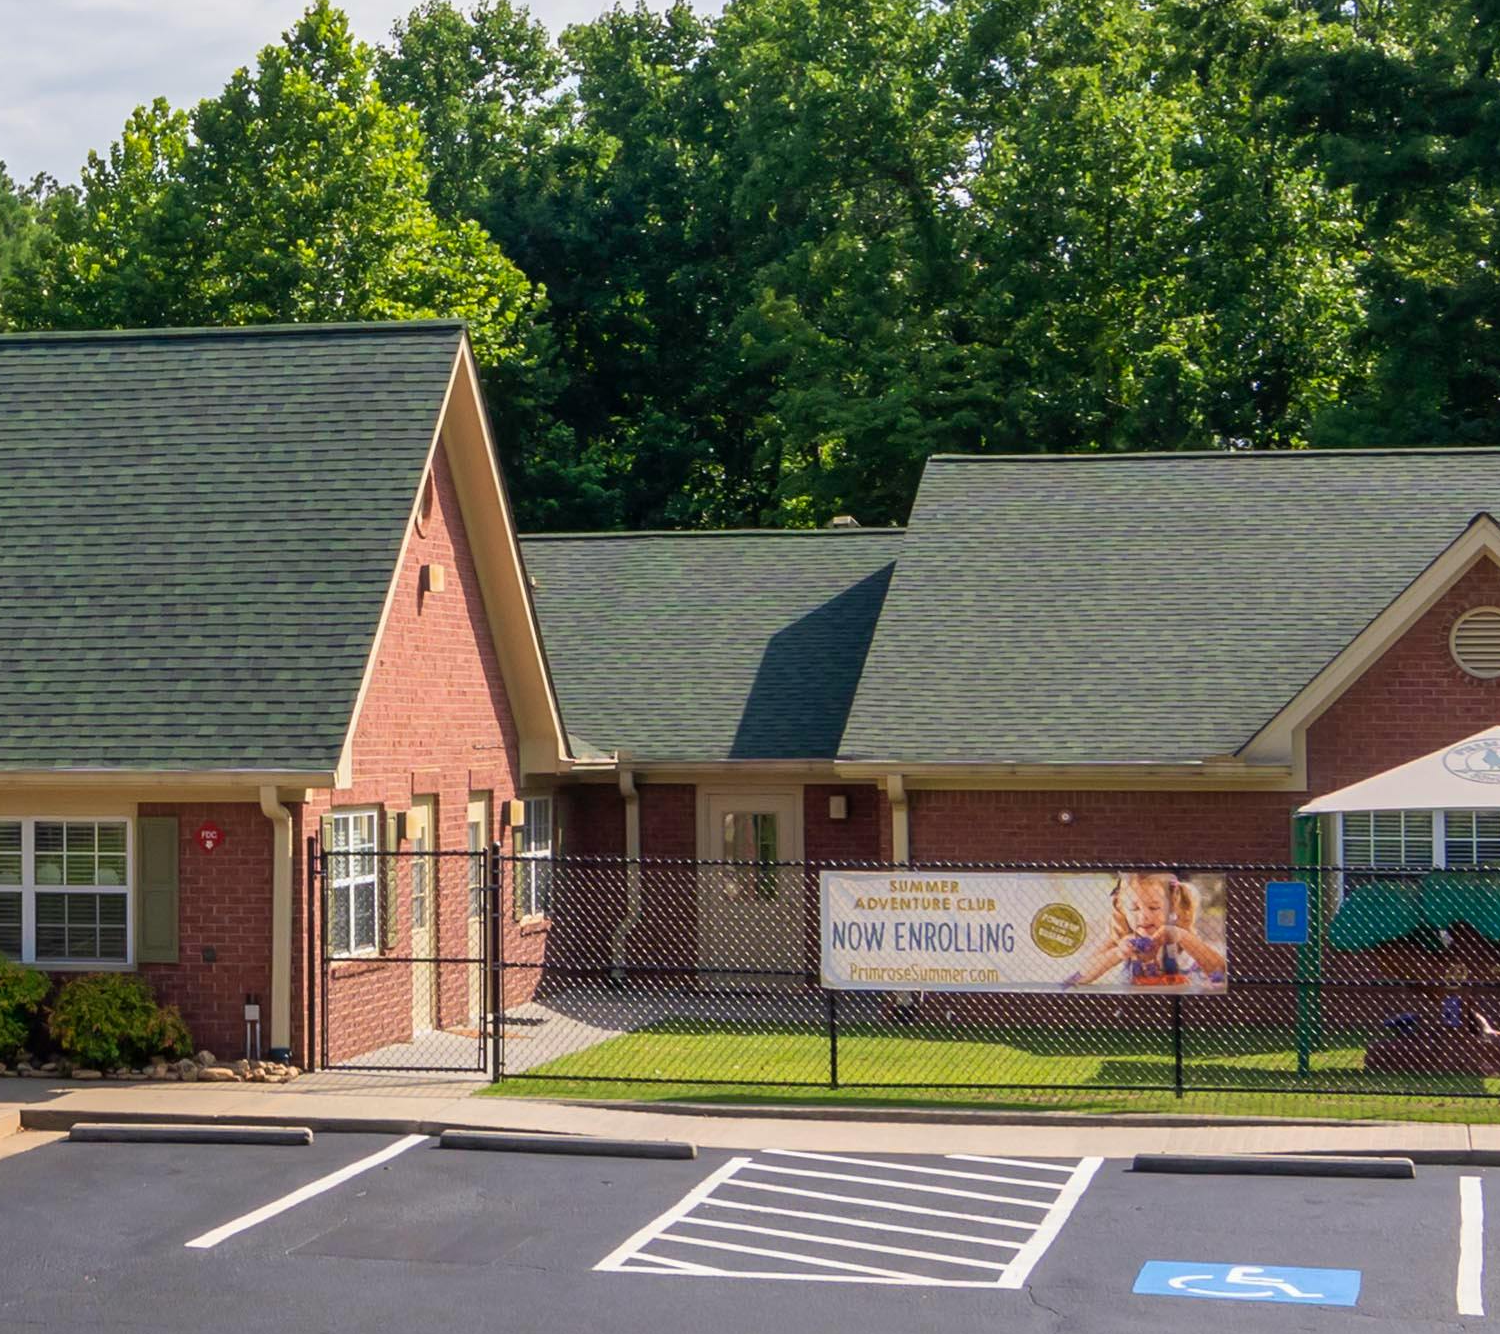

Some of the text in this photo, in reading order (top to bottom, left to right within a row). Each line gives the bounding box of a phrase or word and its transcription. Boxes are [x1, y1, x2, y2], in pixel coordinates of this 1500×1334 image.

[889, 880, 960, 894] SUMMER
[854, 897, 997, 911] ADVENTURE CLUB
[832, 920, 885, 952] NOW
[894, 921, 1015, 953] ENROLLING
[850, 962, 1000, 984] PrimroseSummer.com
